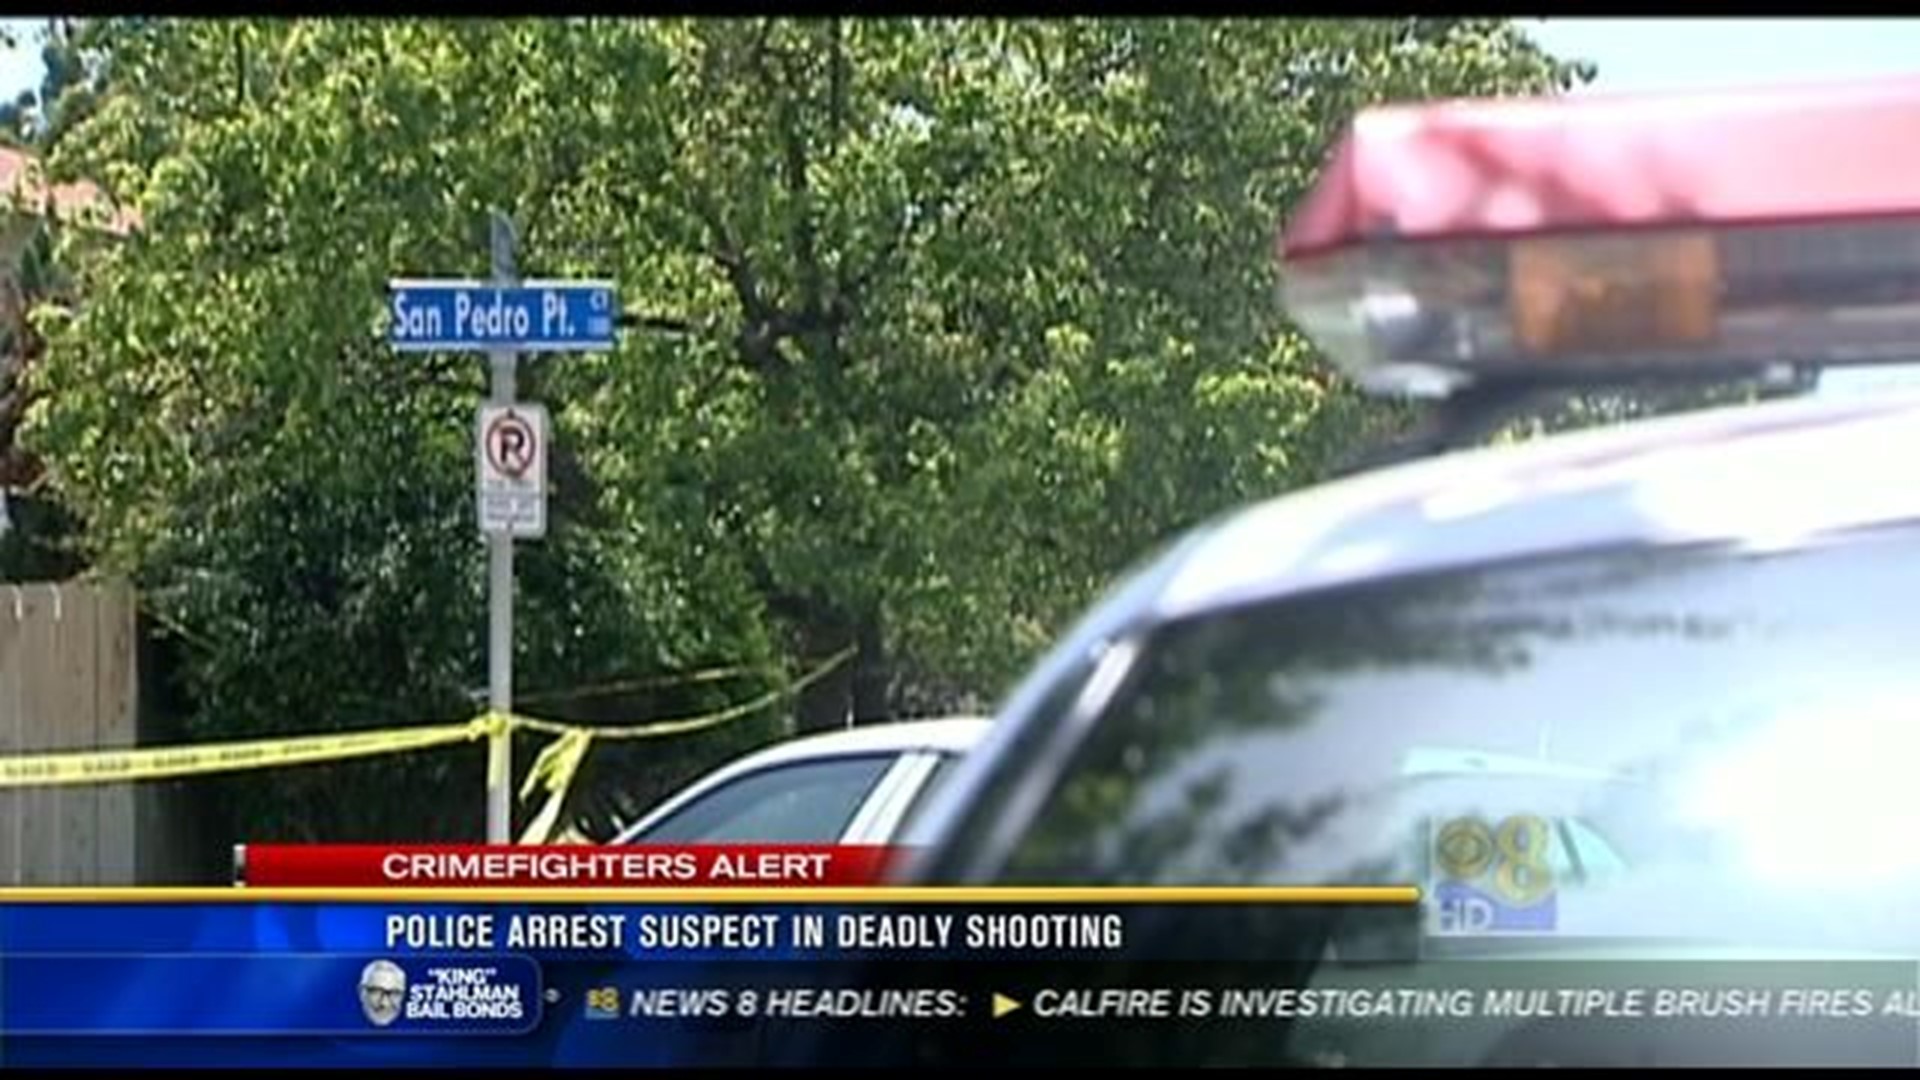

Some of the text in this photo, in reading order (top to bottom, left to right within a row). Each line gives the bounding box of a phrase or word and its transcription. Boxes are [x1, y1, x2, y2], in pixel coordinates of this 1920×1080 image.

[394, 291, 576, 338] San Pedro Pt.
